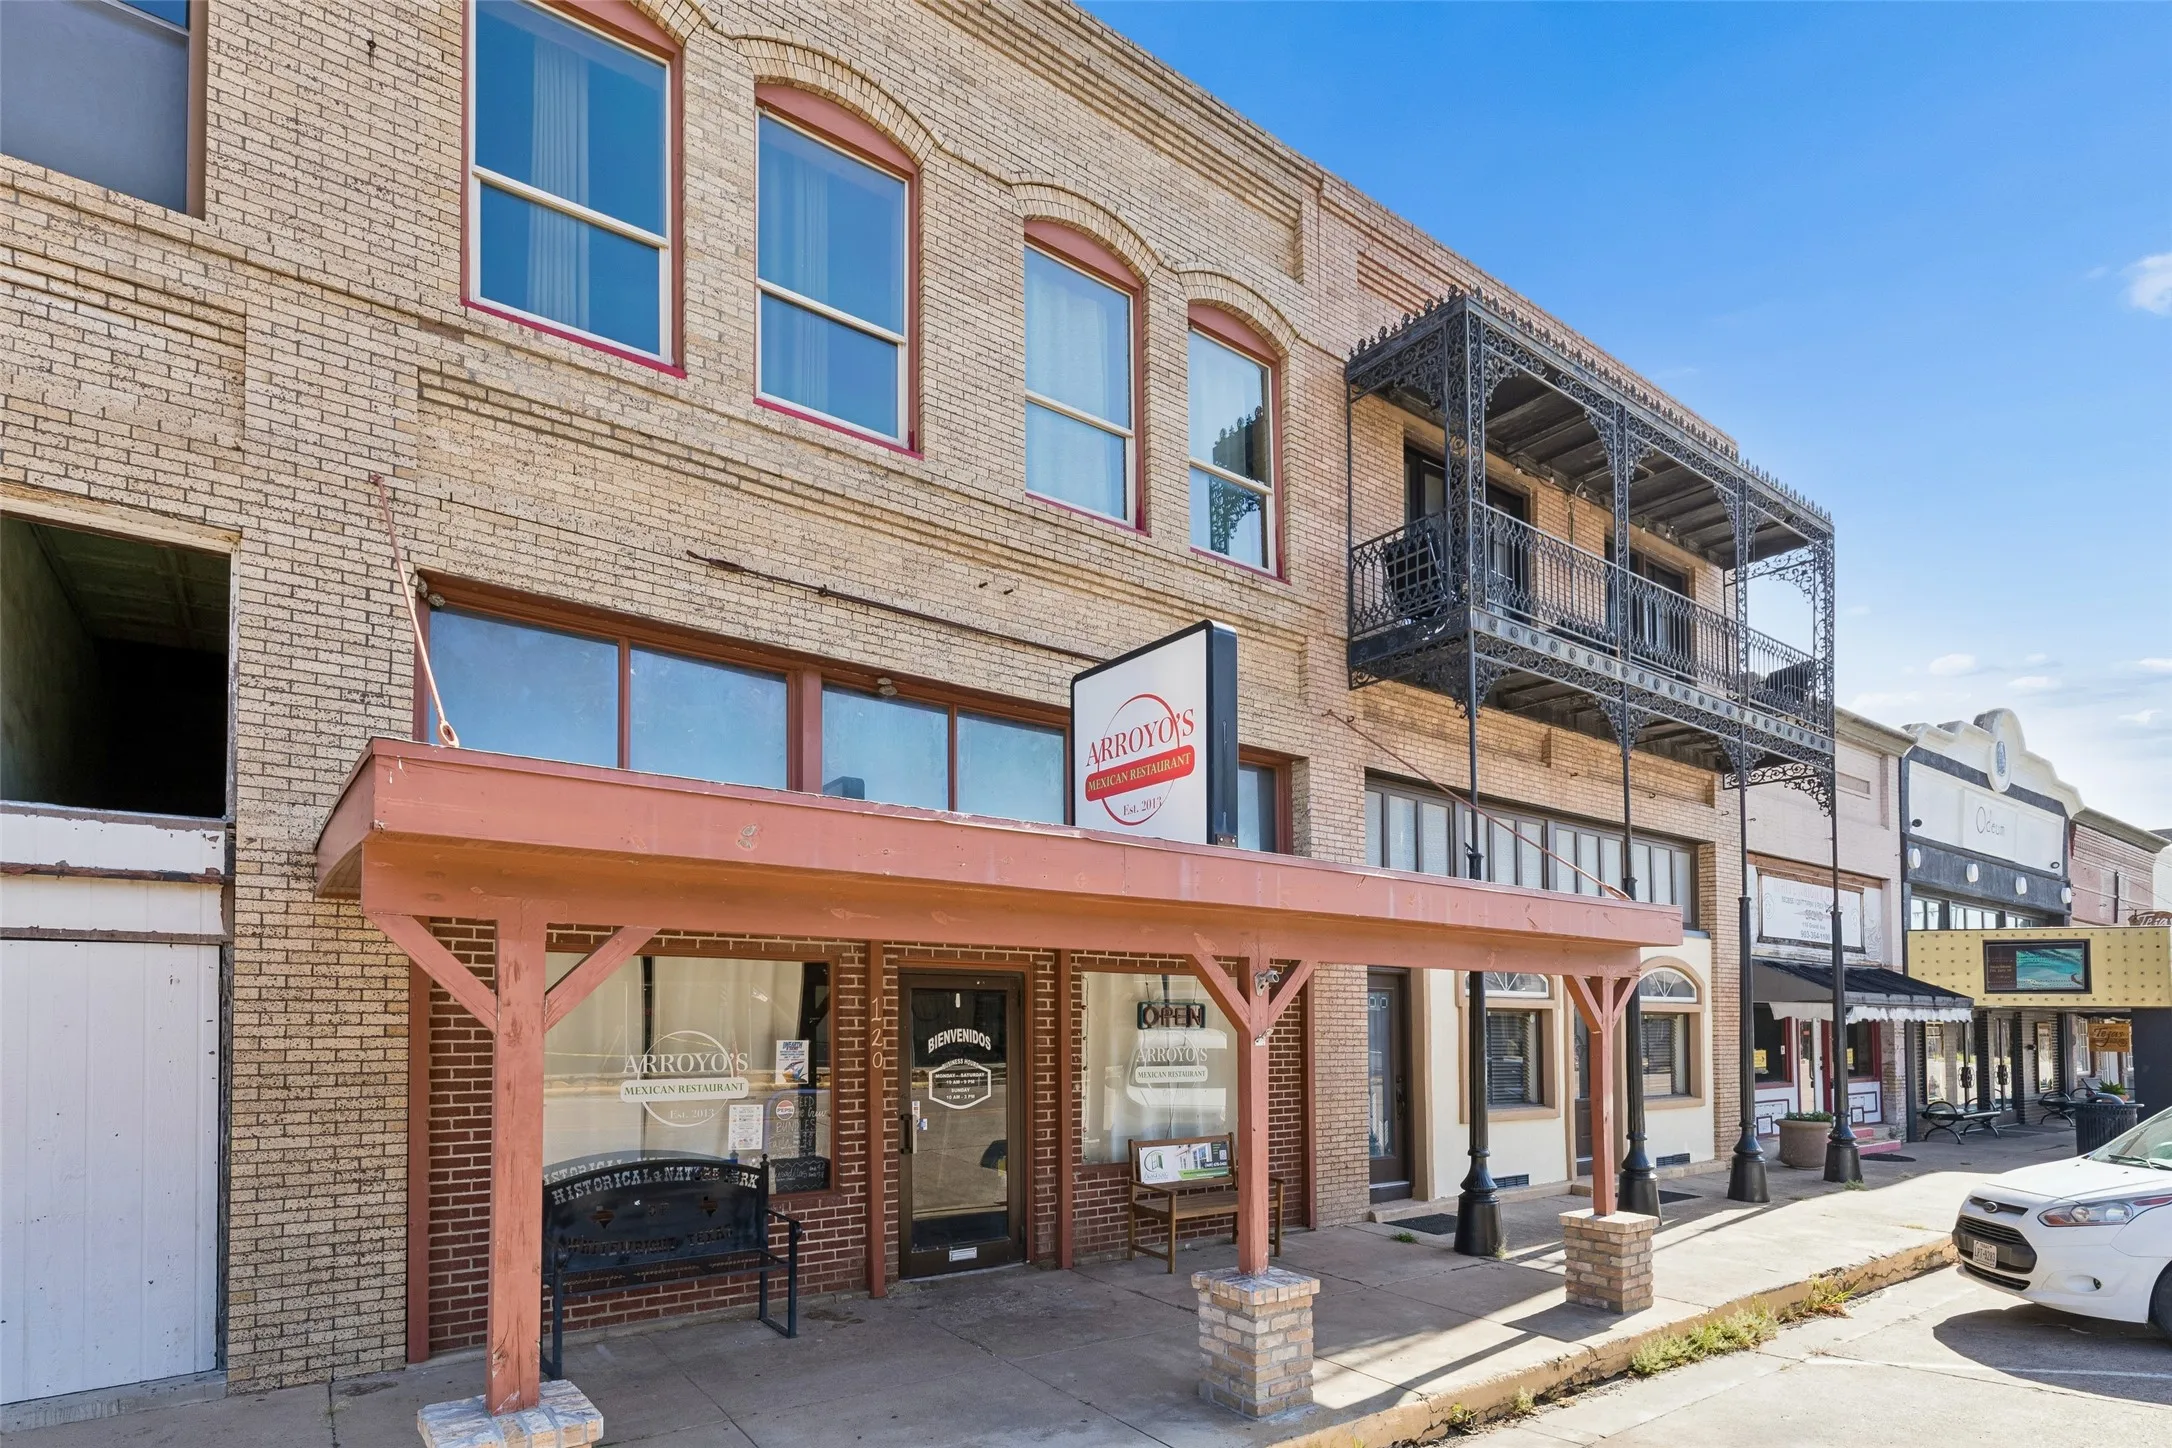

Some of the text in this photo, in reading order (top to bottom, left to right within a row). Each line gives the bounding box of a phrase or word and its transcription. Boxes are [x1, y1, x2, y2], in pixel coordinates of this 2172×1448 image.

[1086, 708, 1194, 767] ARROYO'S
[1088, 752, 1192, 792] MEXICAN RESTAURANT
[1123, 804, 1139, 816] Est.
[1143, 1006, 1202, 1027] OPEN
[871, 997, 883, 1069] 120
[928, 1028, 991, 1054] BIENVENIDOS
[2094, 1027, 2125, 1047] Tejas
[622, 1053, 749, 1074] ARROYO'S
[941, 1058, 963, 1070] BUSINESS
[1136, 1047, 1208, 1063] ARROYO'S
[1138, 1070, 1206, 1079] MEXICAN RESTAURANT
[624, 1082, 745, 1096] MEXICAN RESTAURANT
[552, 1168, 652, 1206] HISTORICAL
